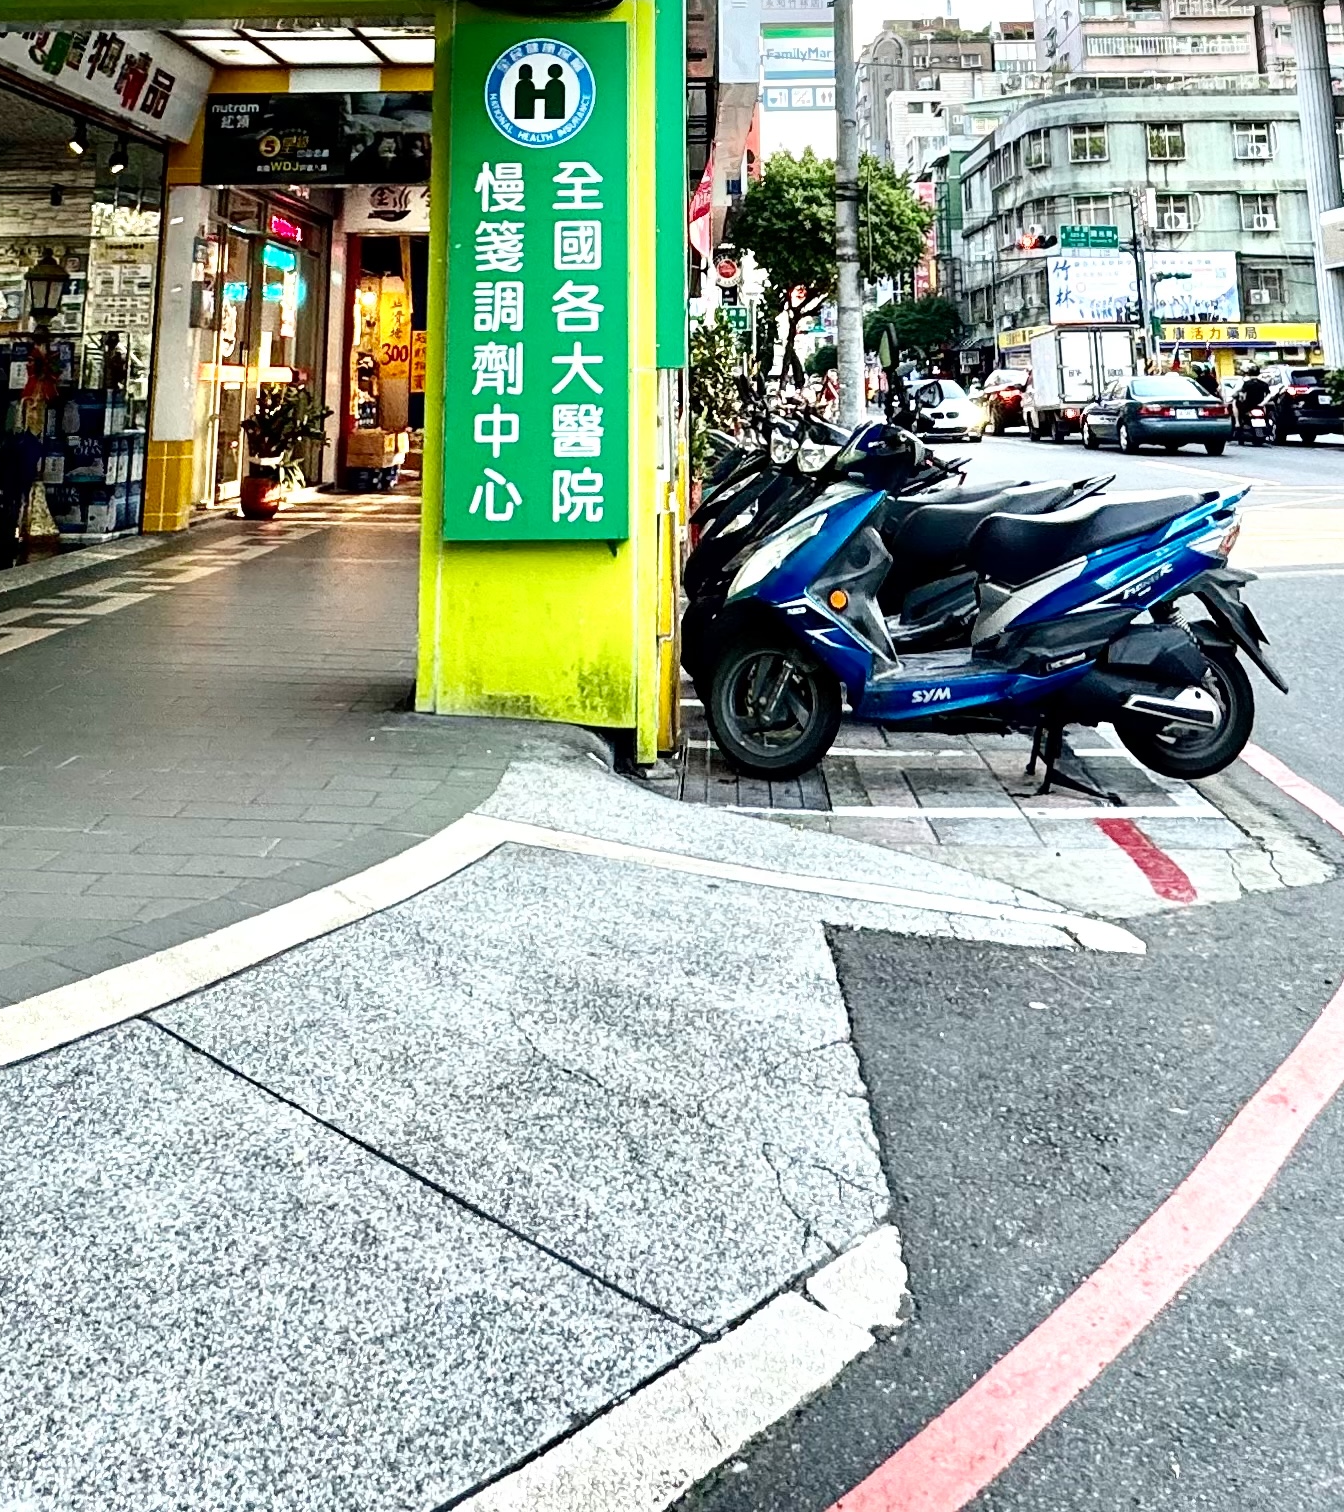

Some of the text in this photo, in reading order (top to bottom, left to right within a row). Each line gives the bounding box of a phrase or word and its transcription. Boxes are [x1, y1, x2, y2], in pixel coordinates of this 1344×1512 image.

[766, 46, 833, 62] FamilyMar
[211, 103, 260, 113] nutram
[517, 131, 554, 143] HEALTH
[1052, 259, 1076, 308] 竹林
[469, 160, 526, 524] 慢箋調劑中心
[551, 160, 605, 525] 全國各大醫院
[381, 342, 409, 366] 300
[911, 686, 952, 704] SYM
